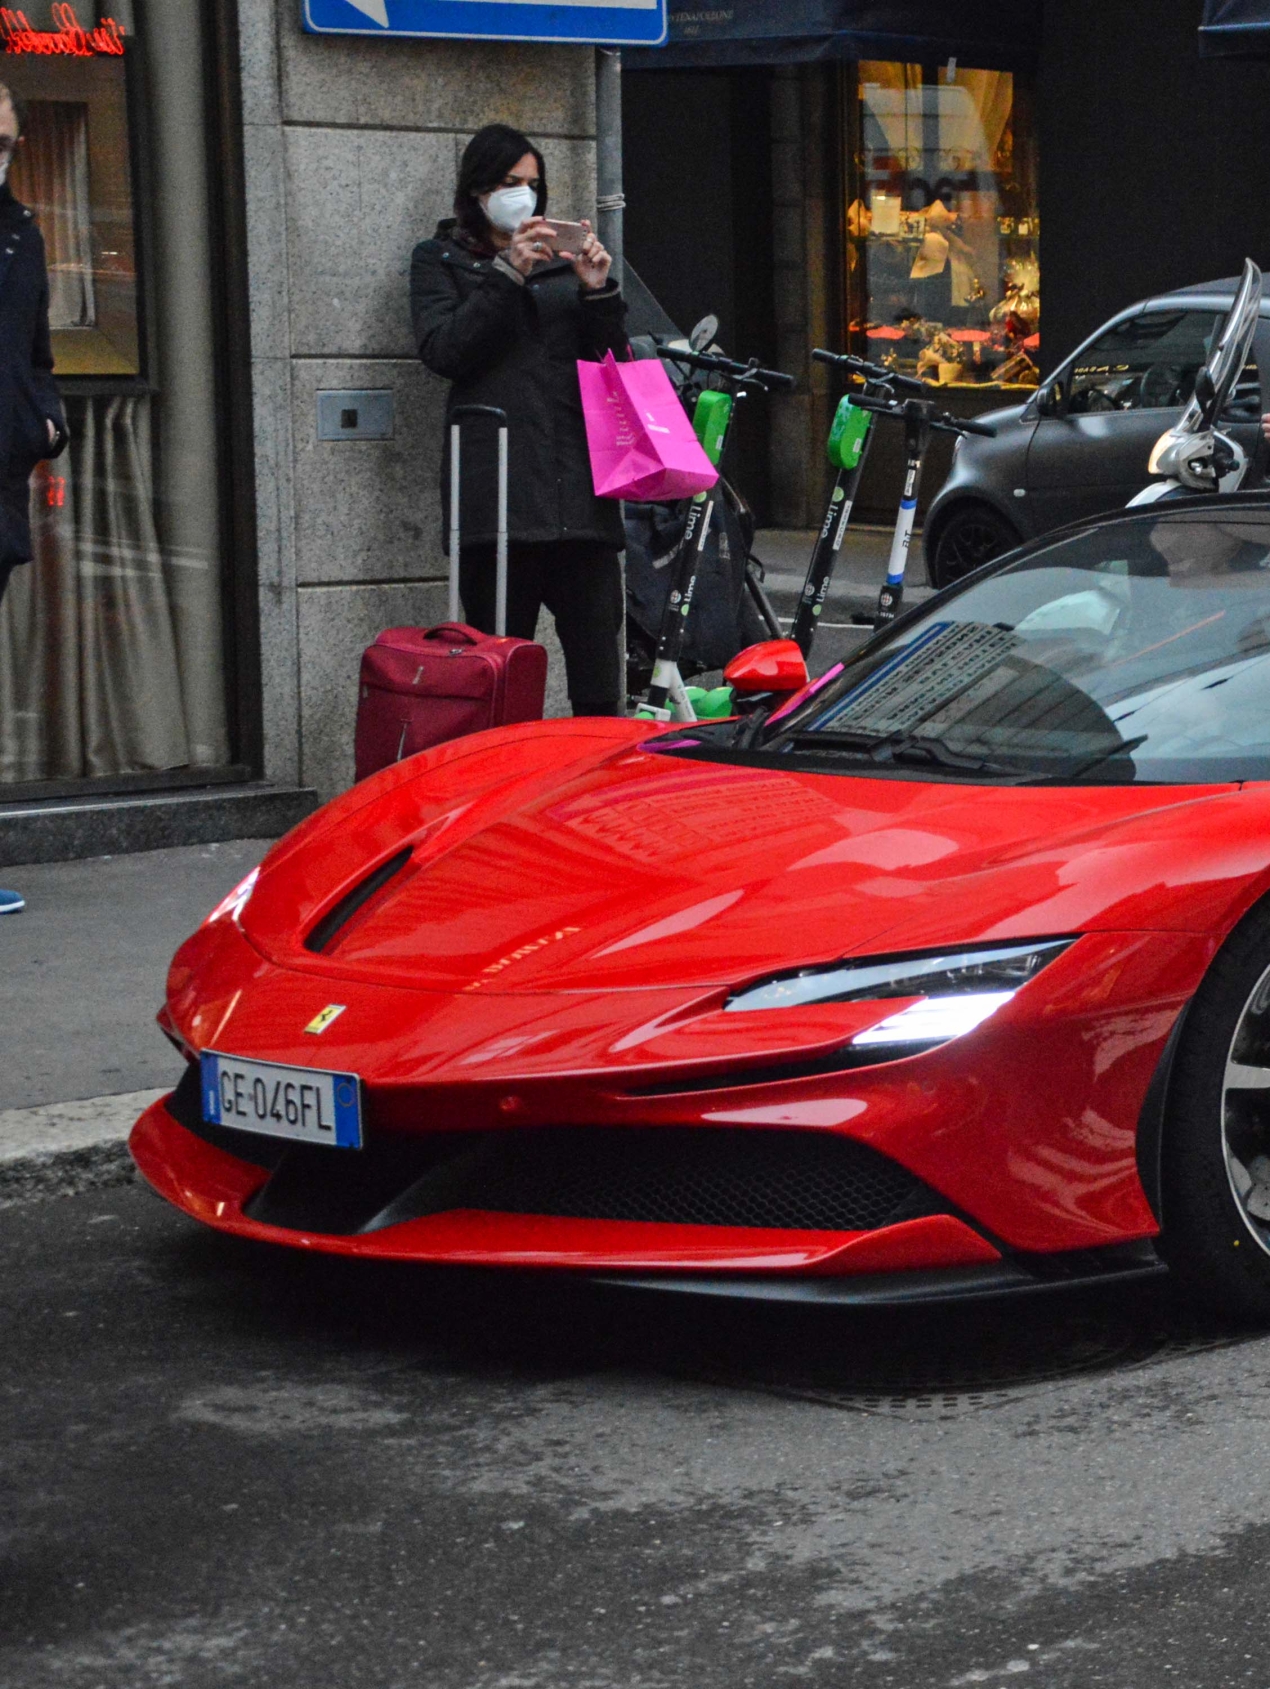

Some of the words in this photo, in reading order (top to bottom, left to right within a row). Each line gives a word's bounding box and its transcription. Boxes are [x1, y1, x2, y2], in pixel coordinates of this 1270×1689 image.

[684, 506, 702, 540] Lime
[820, 504, 839, 539] Lime
[683, 575, 697, 602] Lime
[816, 575, 830, 602] Lime
